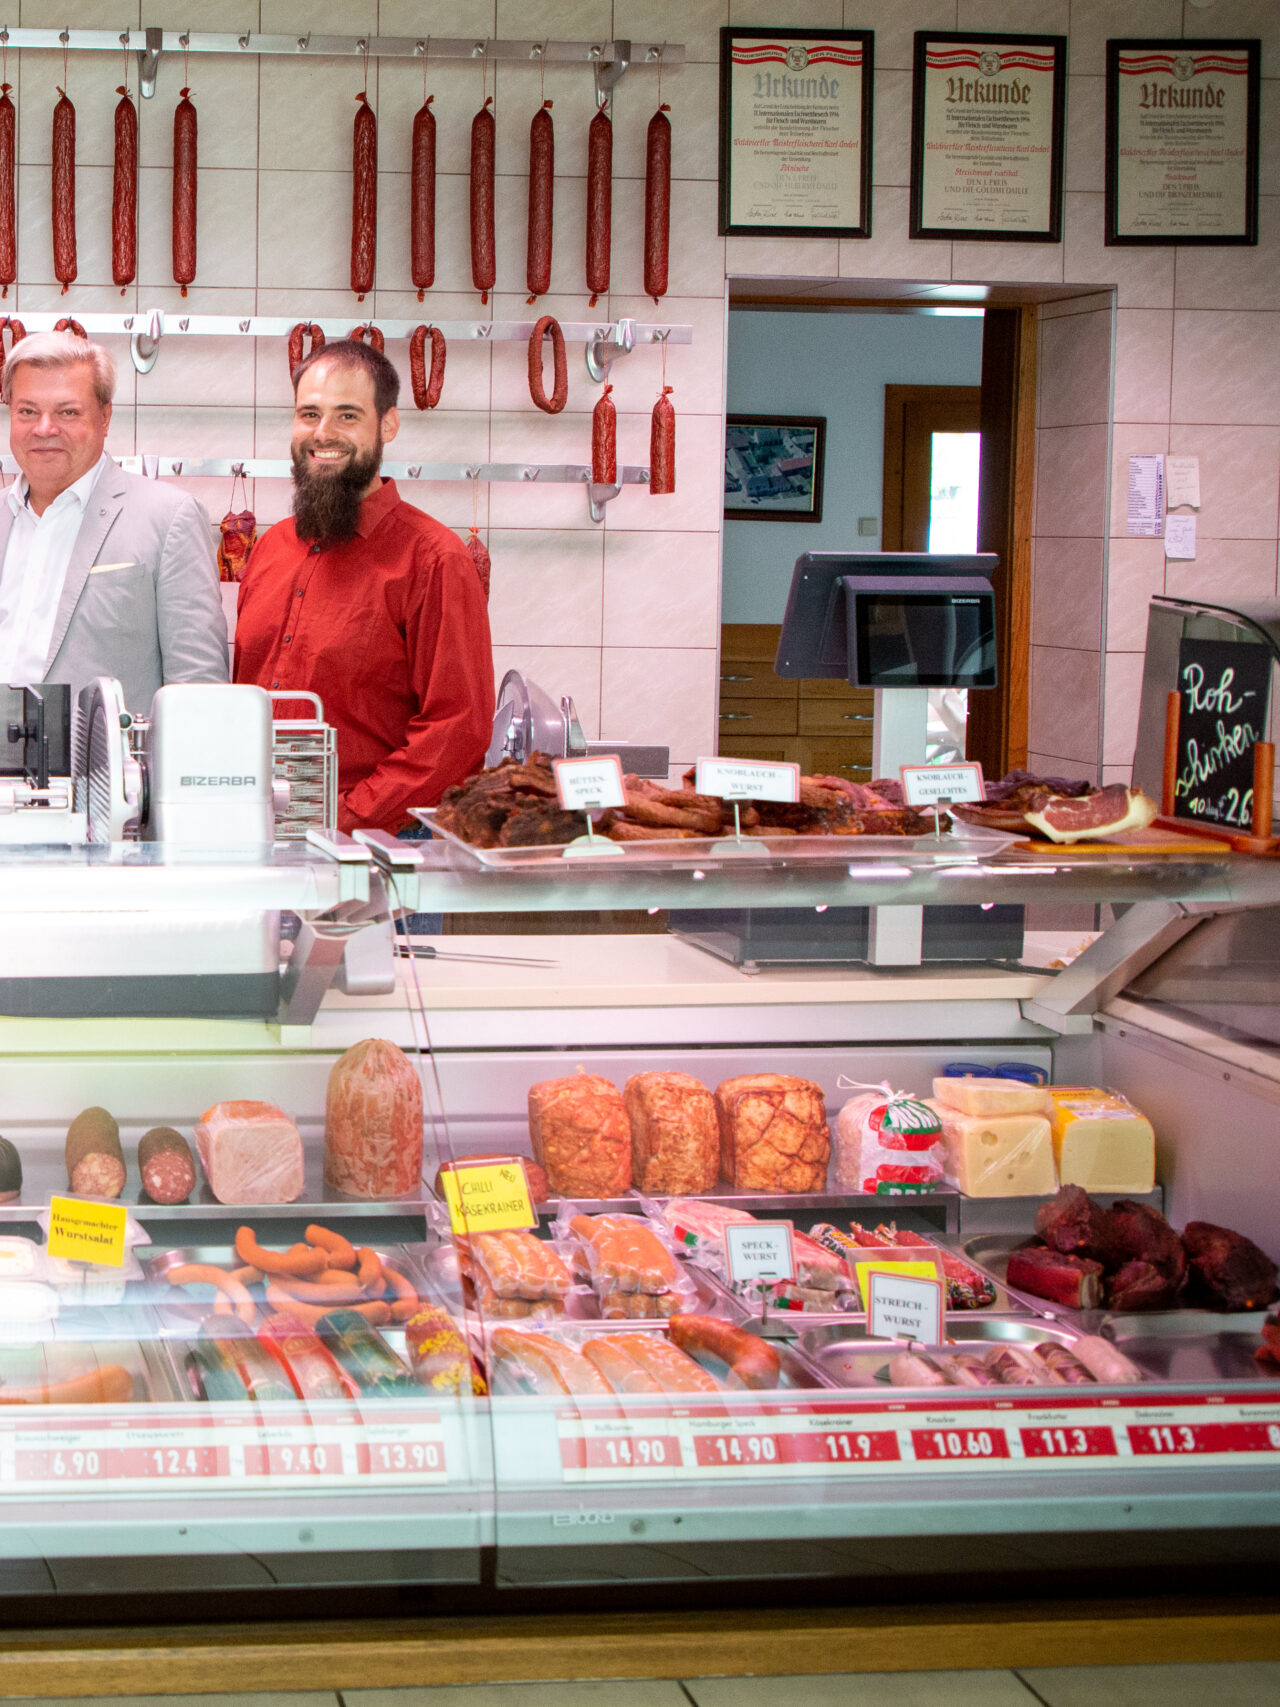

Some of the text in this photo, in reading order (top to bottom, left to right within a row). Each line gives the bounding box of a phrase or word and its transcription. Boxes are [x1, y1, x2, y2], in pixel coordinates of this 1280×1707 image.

[753, 72, 840, 99] Urkunde
[944, 77, 1032, 104] Urkunde
[1139, 82, 1225, 109] Urkunde
[1183, 663, 1256, 714] Roh-
[1175, 719, 1260, 797] schinken
[180, 775, 257, 787] BIZERBA
[574, 786, 603, 796] SPECK
[730, 782, 764, 792] WURST
[1225, 787, 1254, 827] 2,6
[499, 1168, 516, 1183] NEU
[461, 1181, 495, 1196] CHILLI
[456, 1199, 525, 1217] KÄSEKRAINER
[52, 1212, 118, 1232] Hausgemachter
[54, 1226, 114, 1246] Wurstsalat
[741, 1241, 773, 1250] SPECK
[743, 1252, 778, 1261] WURST
[874, 1295, 921, 1311] STREICH
[883, 1314, 923, 1328] WURST
[606, 1439, 666, 1464] 14.90
[716, 1437, 776, 1462] 14.90
[826, 1434, 872, 1459] 11.9
[933, 1432, 994, 1457] 10.60
[1041, 1429, 1089, 1454] 11.3
[1149, 1426, 1196, 1452] 11.3
[53, 1451, 100, 1477] 6.90
[153, 1449, 198, 1475] 12.4
[280, 1447, 327, 1471] 9.40
[380, 1444, 439, 1470] 13.90
